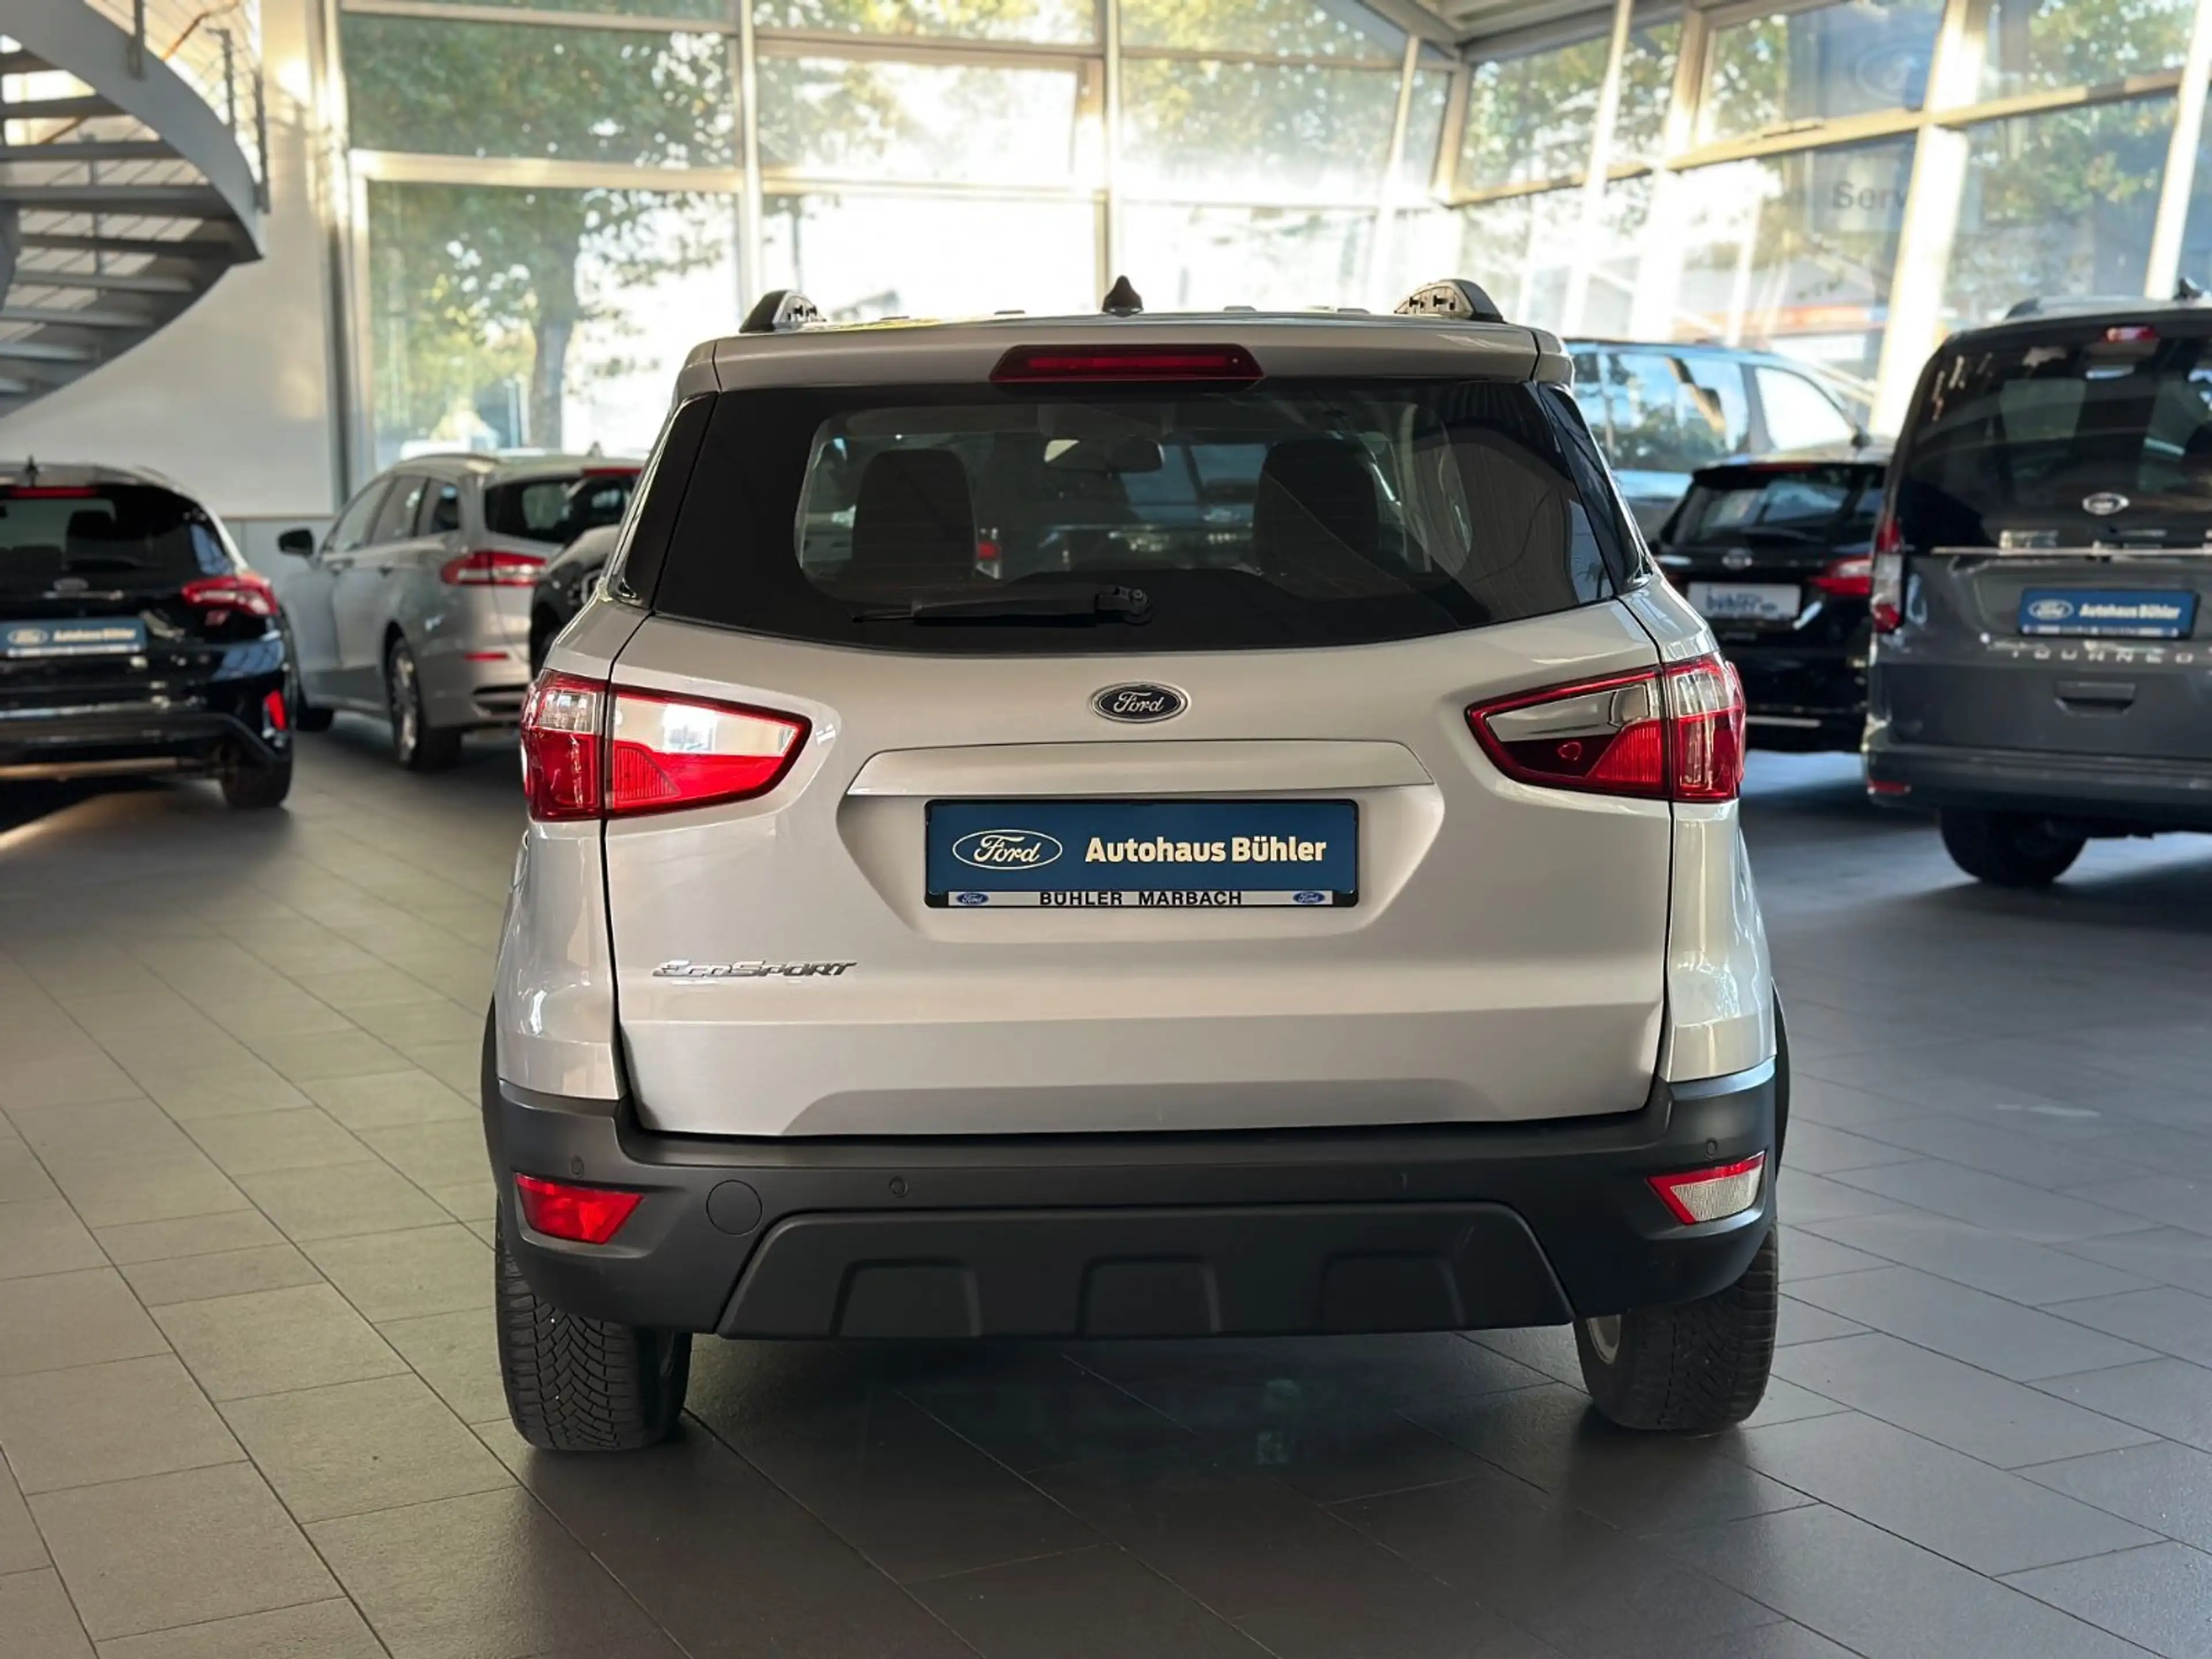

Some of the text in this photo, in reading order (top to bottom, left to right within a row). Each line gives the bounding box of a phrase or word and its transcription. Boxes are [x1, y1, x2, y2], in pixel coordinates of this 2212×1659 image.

[1113, 691, 1165, 713] Ford
[973, 834, 1041, 863] Ford
[1085, 835, 1327, 863] Autohaus Bühler
[961, 892, 983, 903] Ford
[1039, 891, 1242, 906] BÜHLER MARBACH
[1298, 892, 1319, 903] Ford
